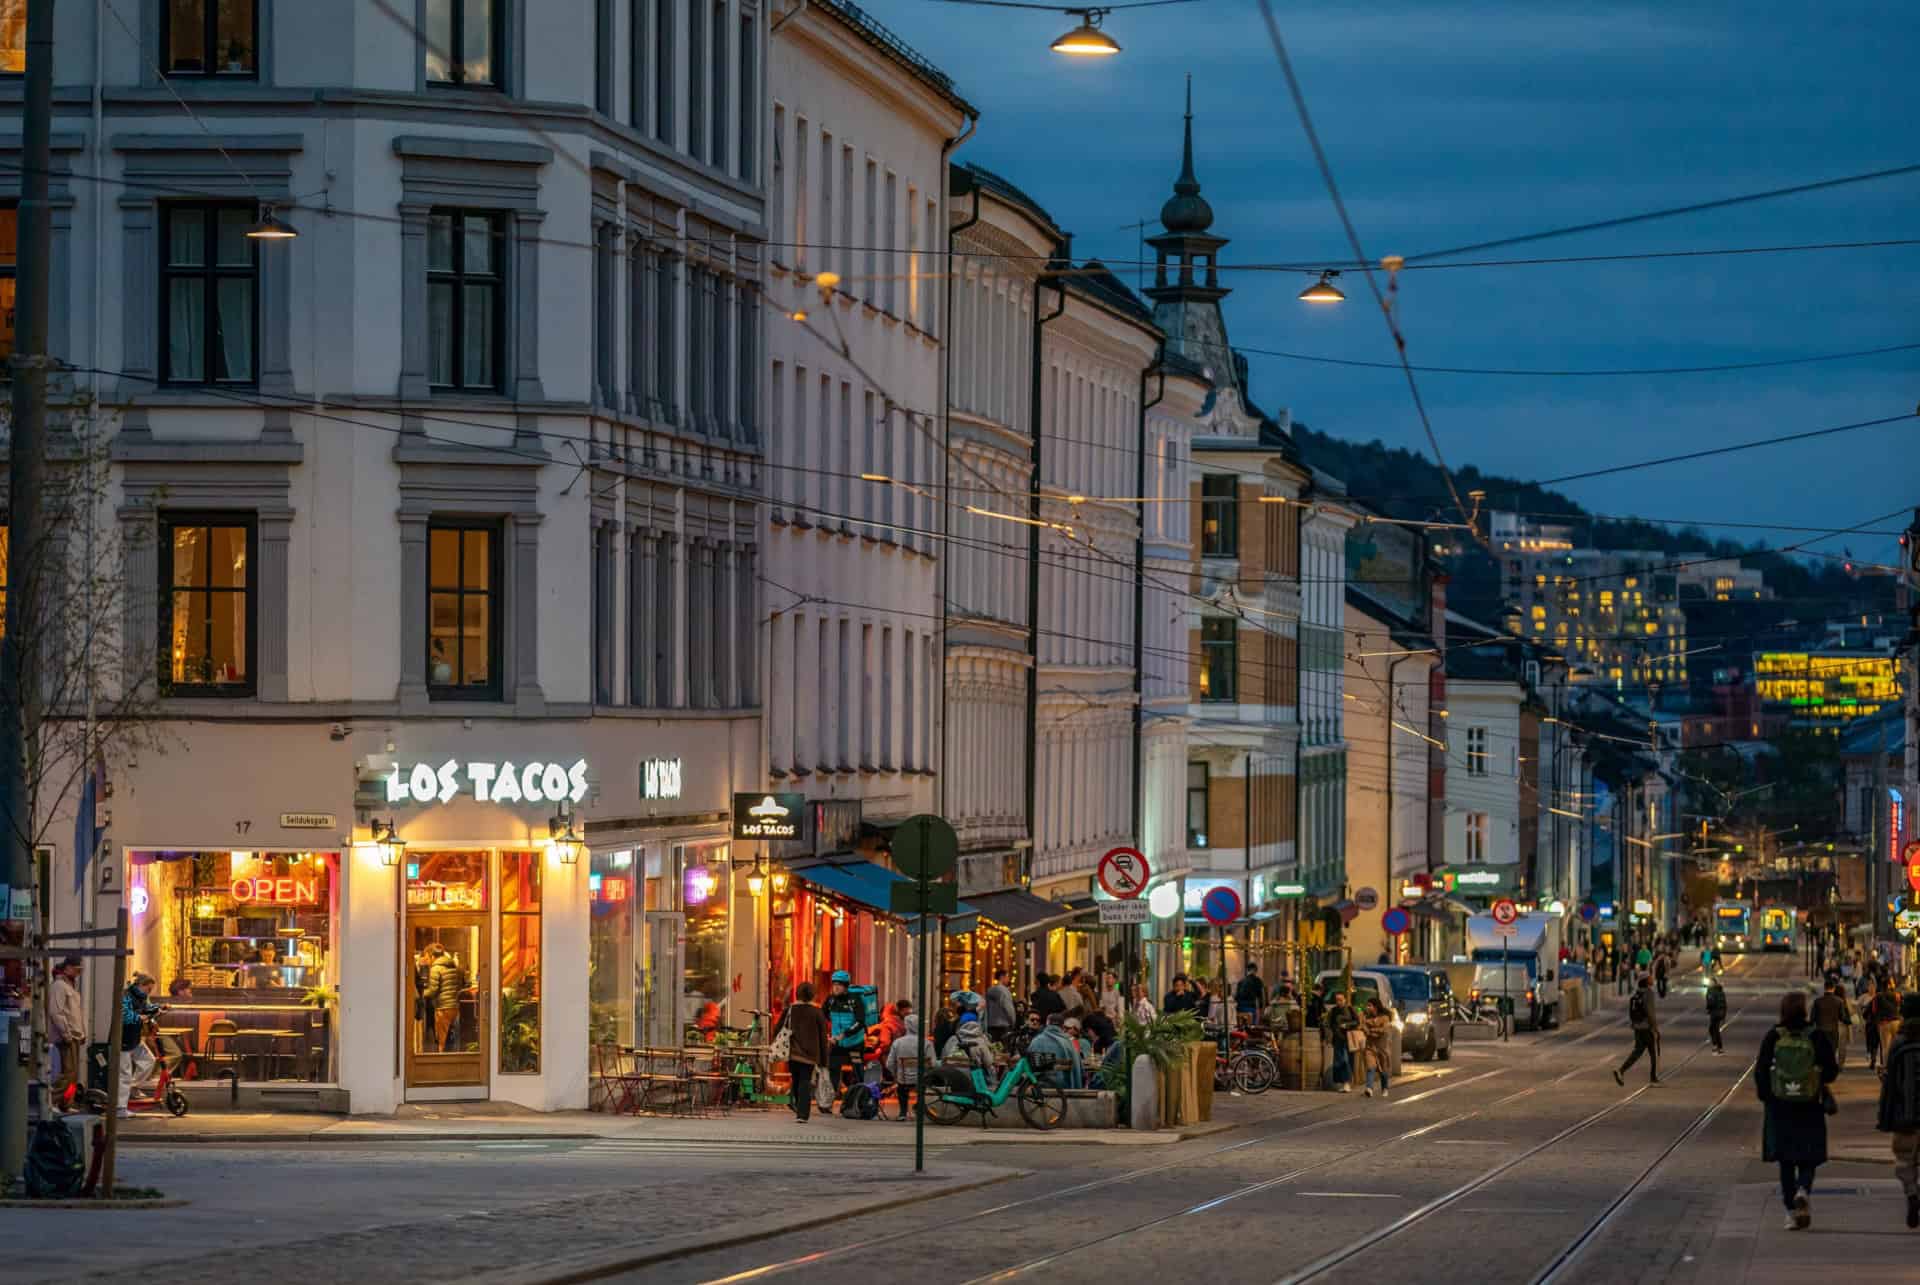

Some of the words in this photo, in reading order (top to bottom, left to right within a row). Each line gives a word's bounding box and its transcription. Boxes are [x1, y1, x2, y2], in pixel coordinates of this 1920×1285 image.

[386, 759, 459, 804] LOS
[467, 758, 589, 804] TACOS
[235, 820, 252, 834] 17
[742, 823, 761, 835] LOS
[763, 823, 795, 836] TACOS
[231, 879, 315, 903] OPEN
